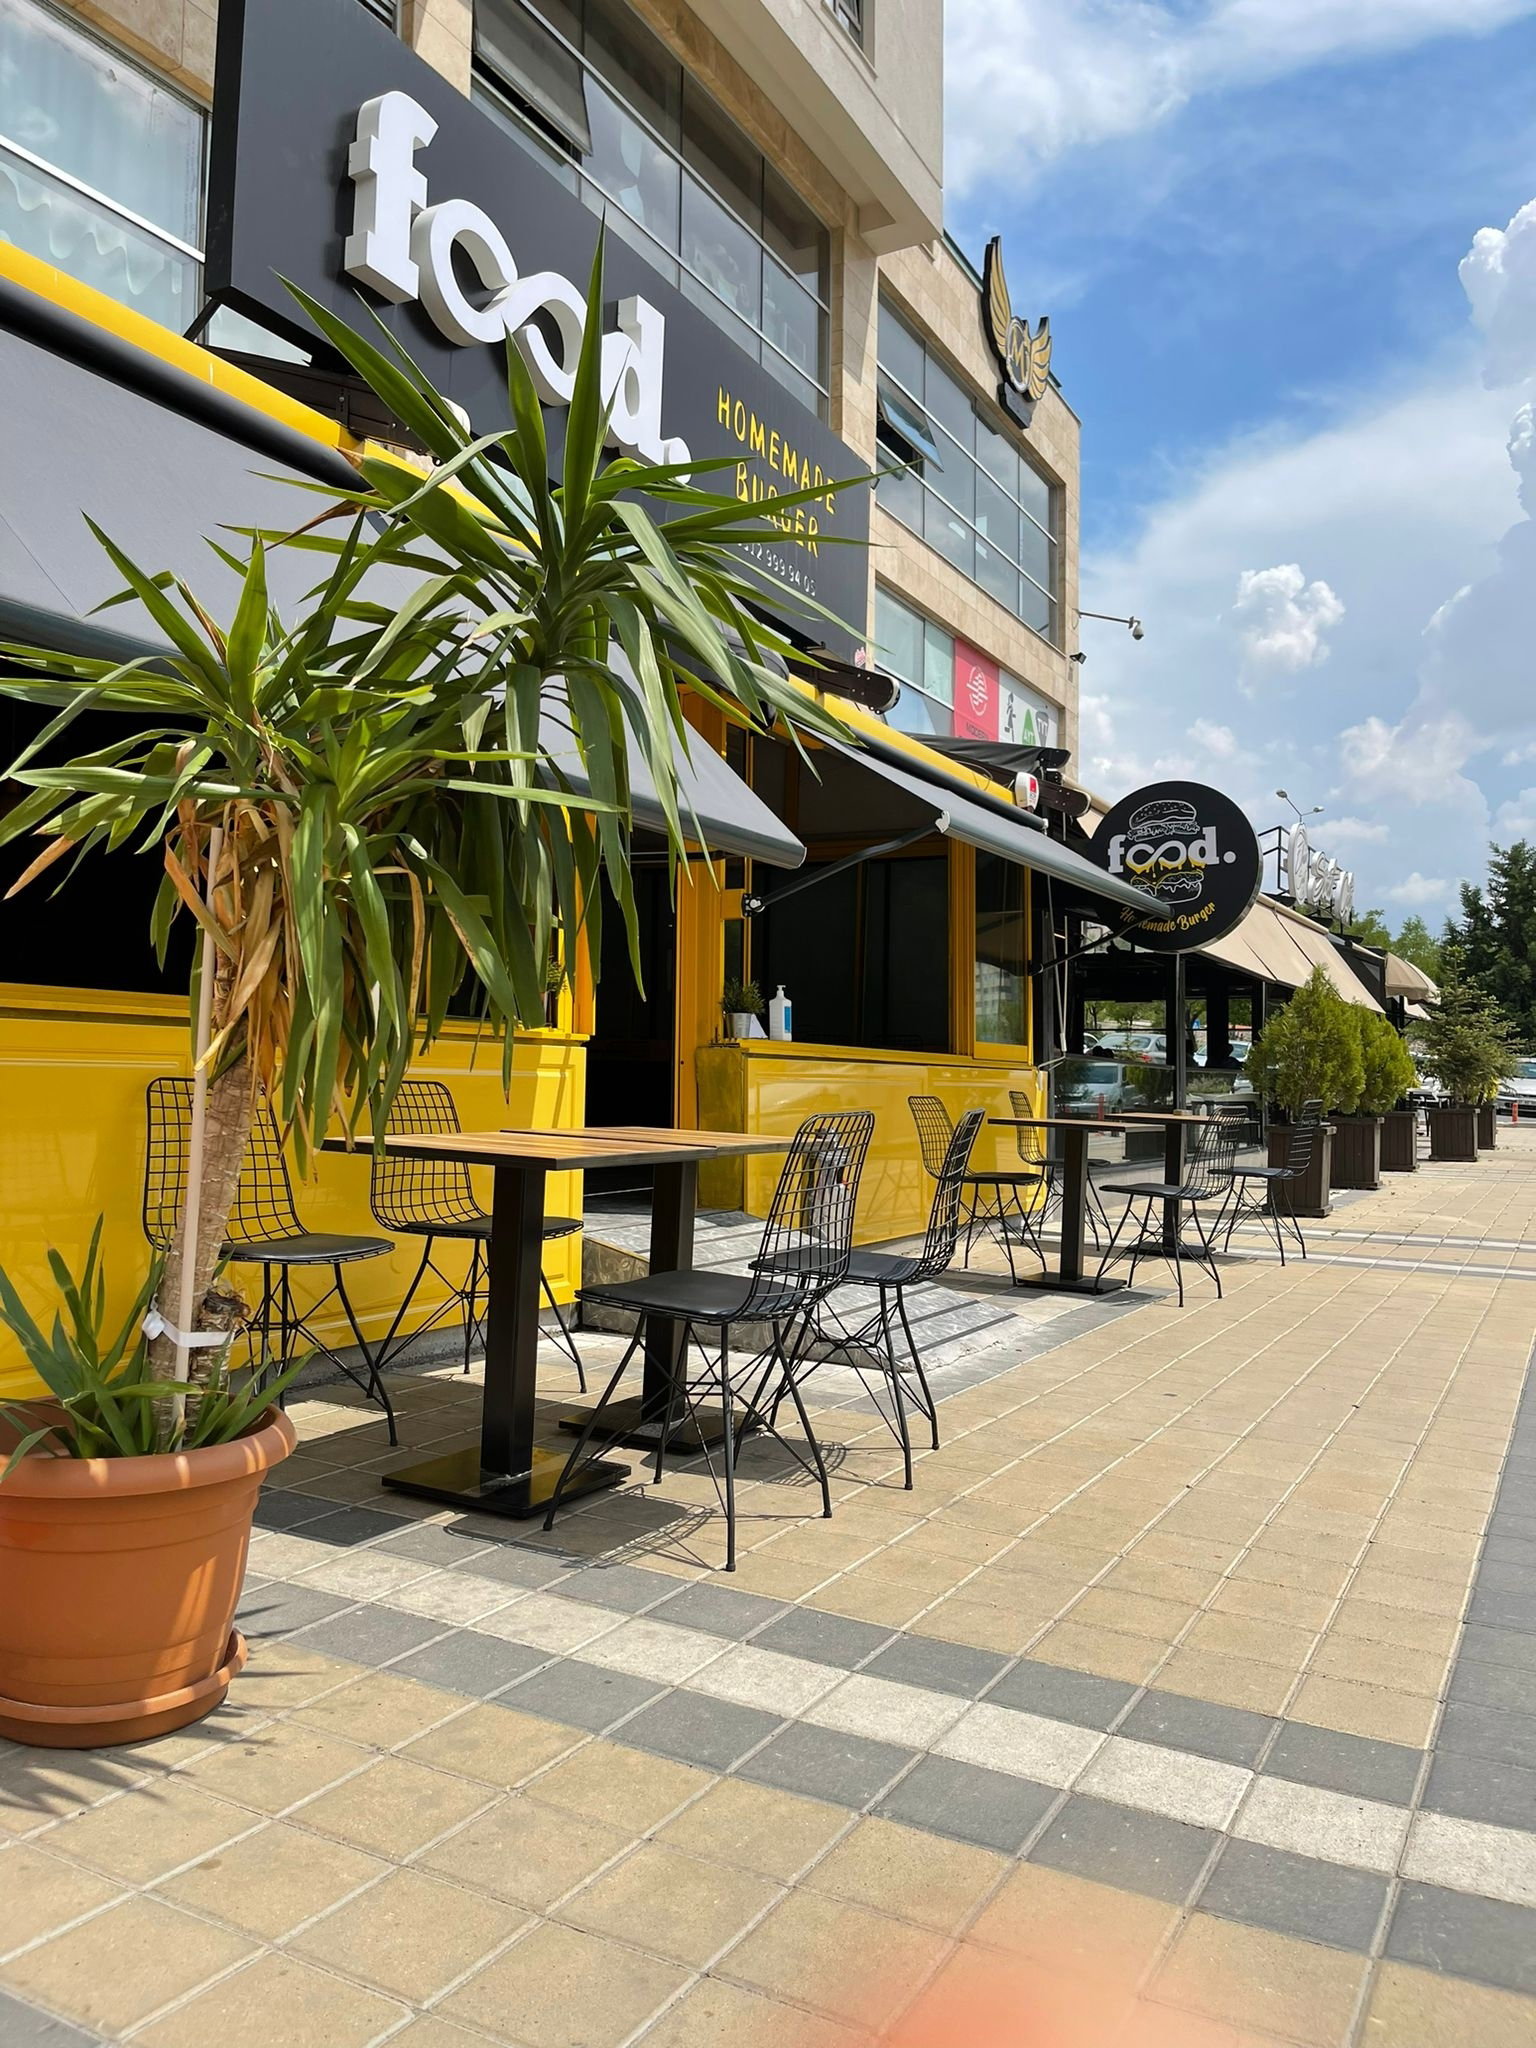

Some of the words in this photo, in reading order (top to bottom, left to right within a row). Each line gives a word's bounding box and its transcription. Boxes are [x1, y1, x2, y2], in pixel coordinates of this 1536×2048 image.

[717, 384, 837, 515] HOMEMADE
[766, 549, 786, 577] 999
[788, 565, 801, 587] 94
[1107, 825, 1237, 874] food.
[1177, 902, 1216, 931] Burger
